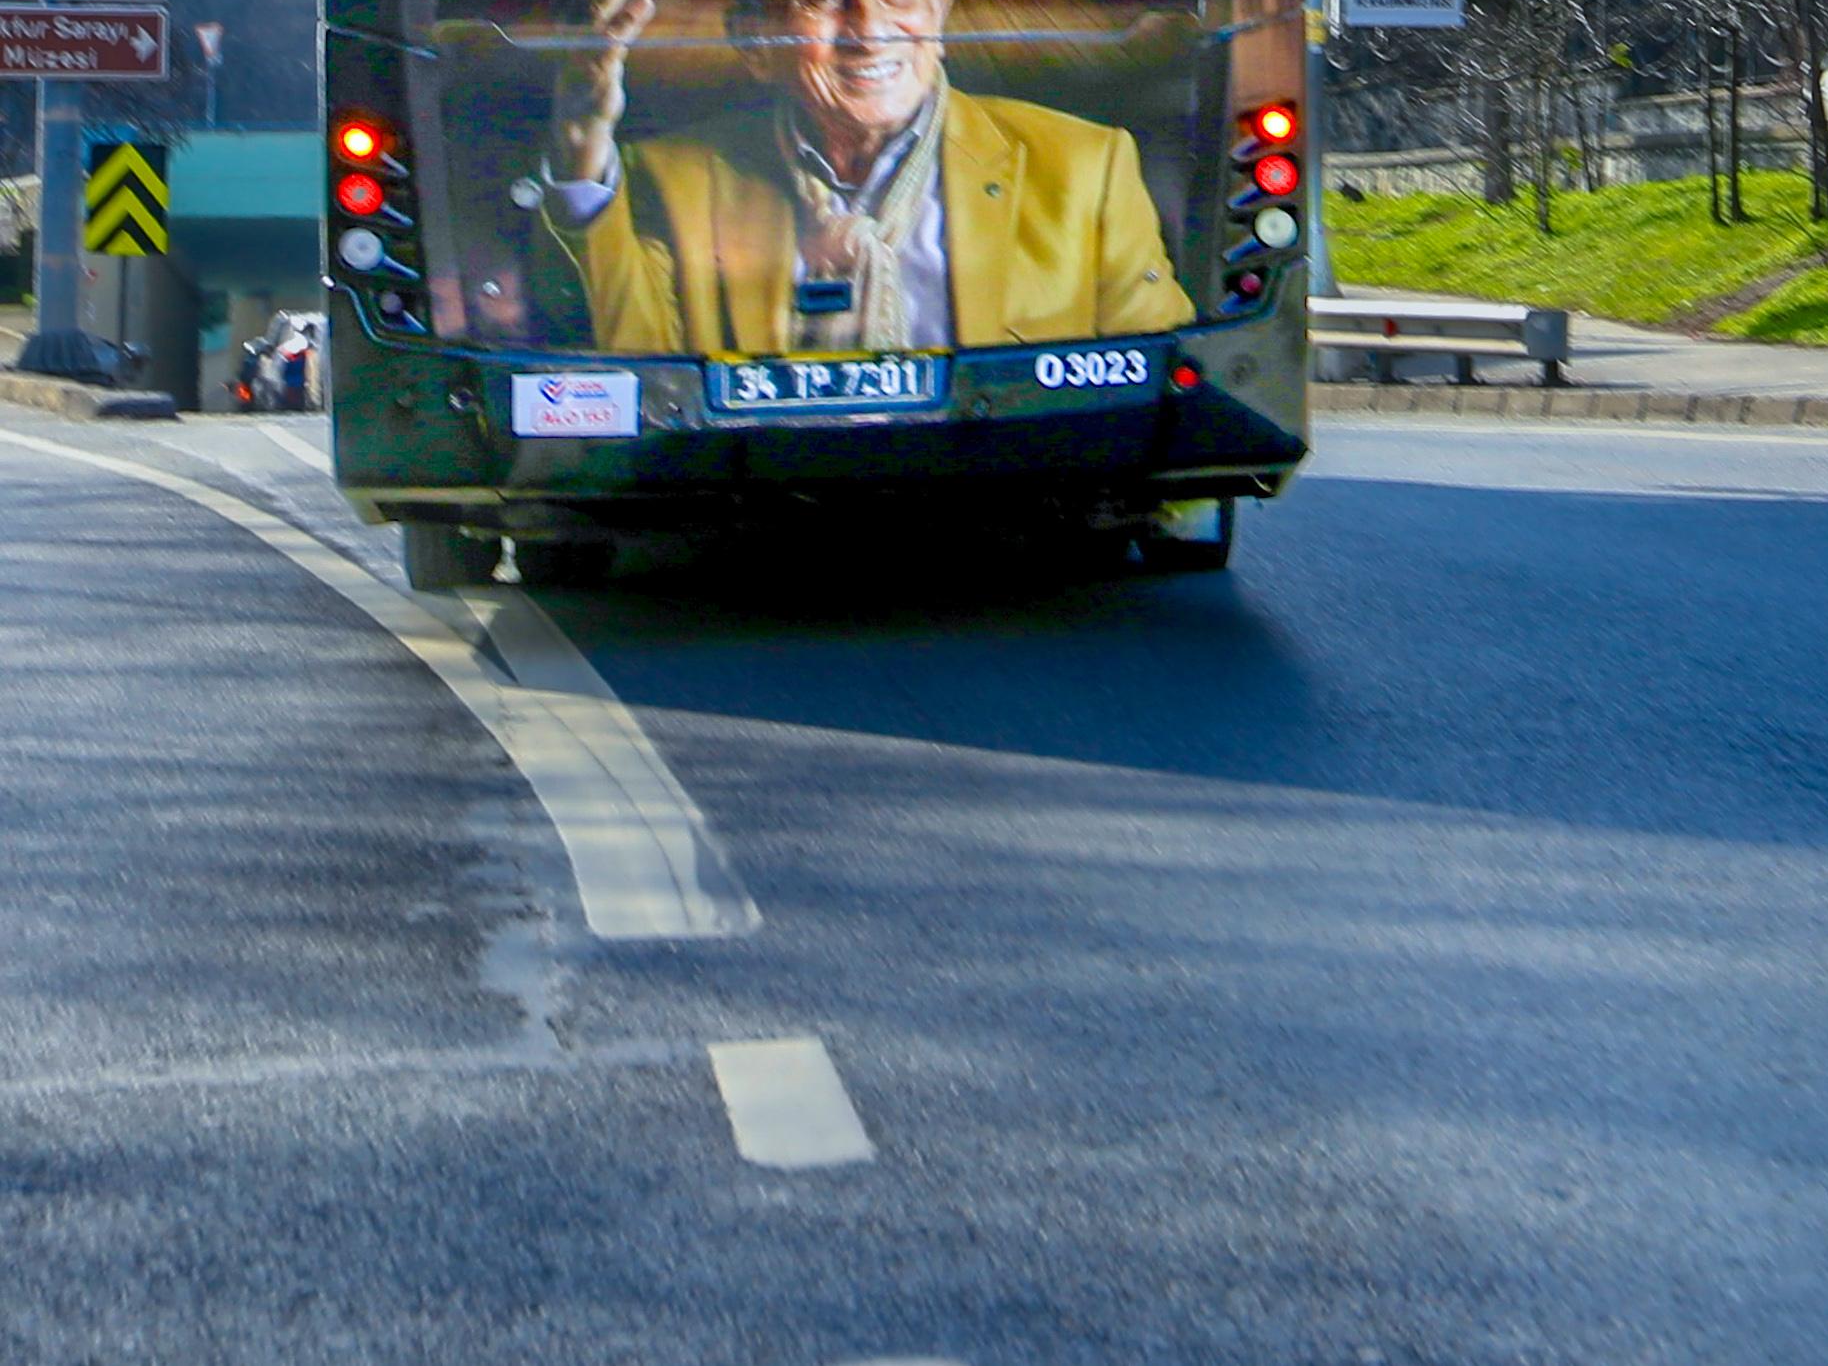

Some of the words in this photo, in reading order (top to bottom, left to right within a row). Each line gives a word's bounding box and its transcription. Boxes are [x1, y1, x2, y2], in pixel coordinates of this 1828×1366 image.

[53, 15, 131, 46] Sarayı
[3, 44, 99, 69] Müzesi
[736, 365, 779, 400] 34
